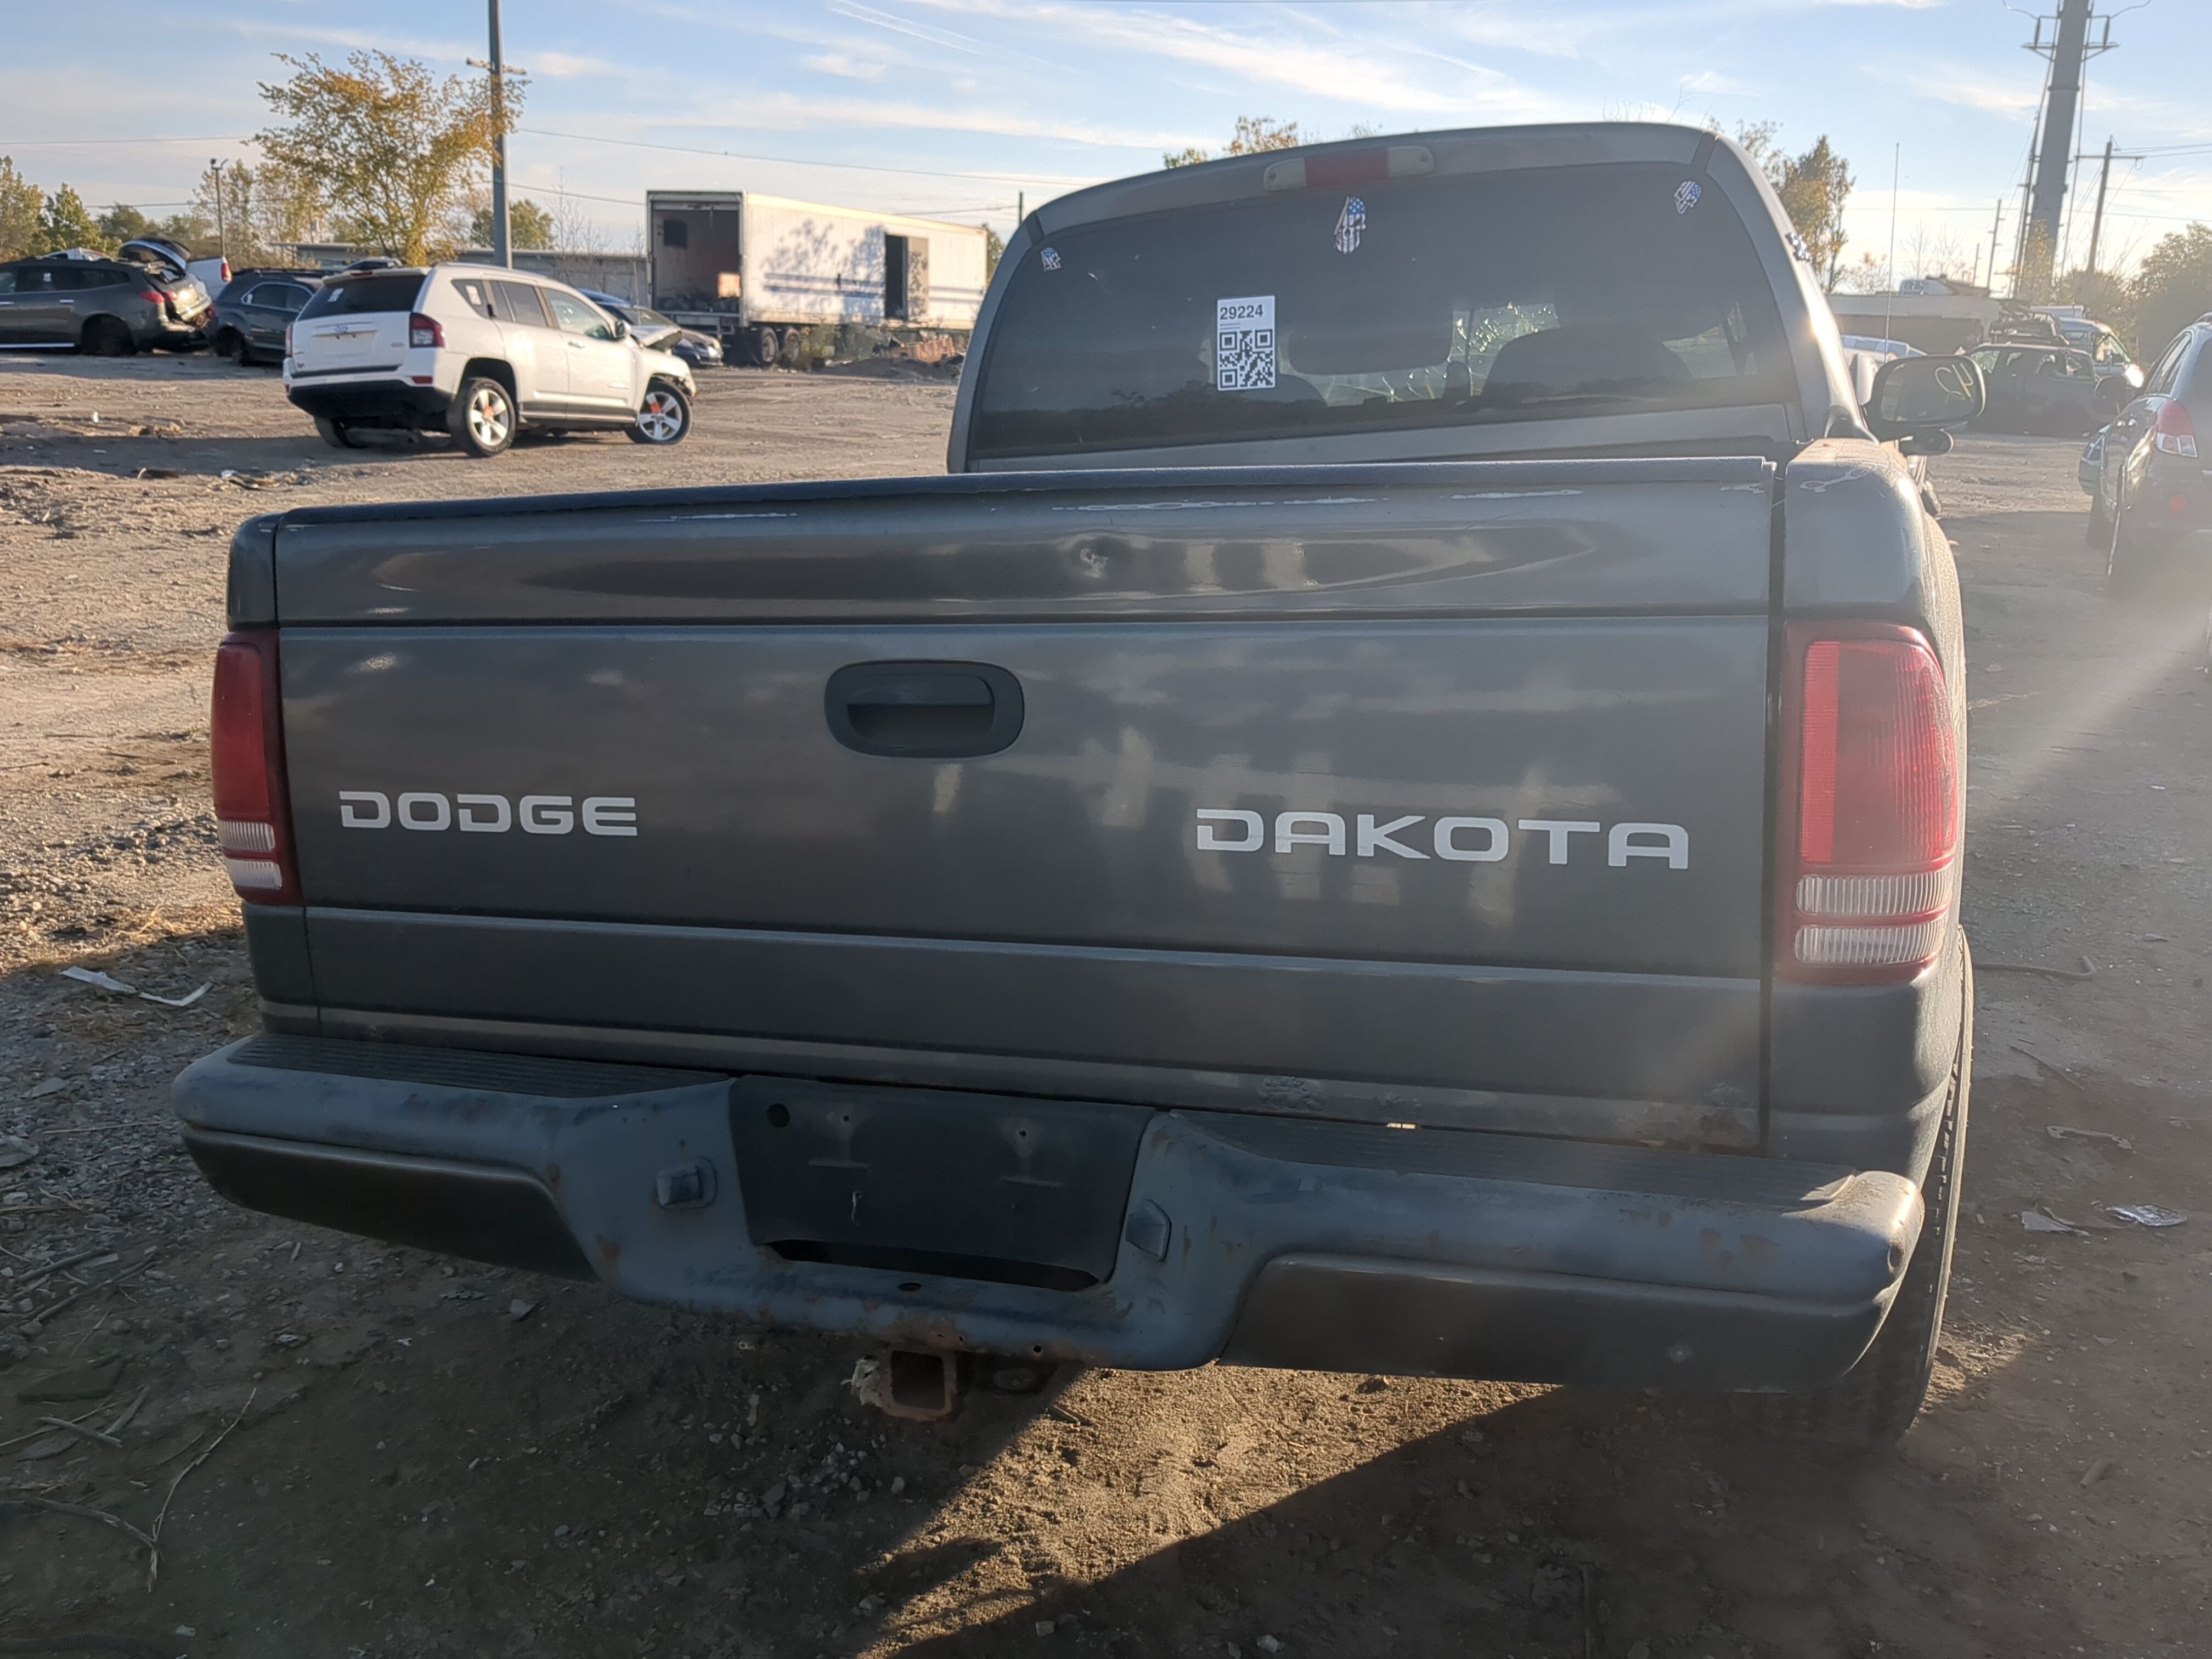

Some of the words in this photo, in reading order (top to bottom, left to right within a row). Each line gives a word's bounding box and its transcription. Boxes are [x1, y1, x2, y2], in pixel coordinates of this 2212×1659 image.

[1220, 304, 1263, 320] 29224
[339, 791, 638, 836] DODGE
[1197, 809, 1689, 870] DAKOTA
